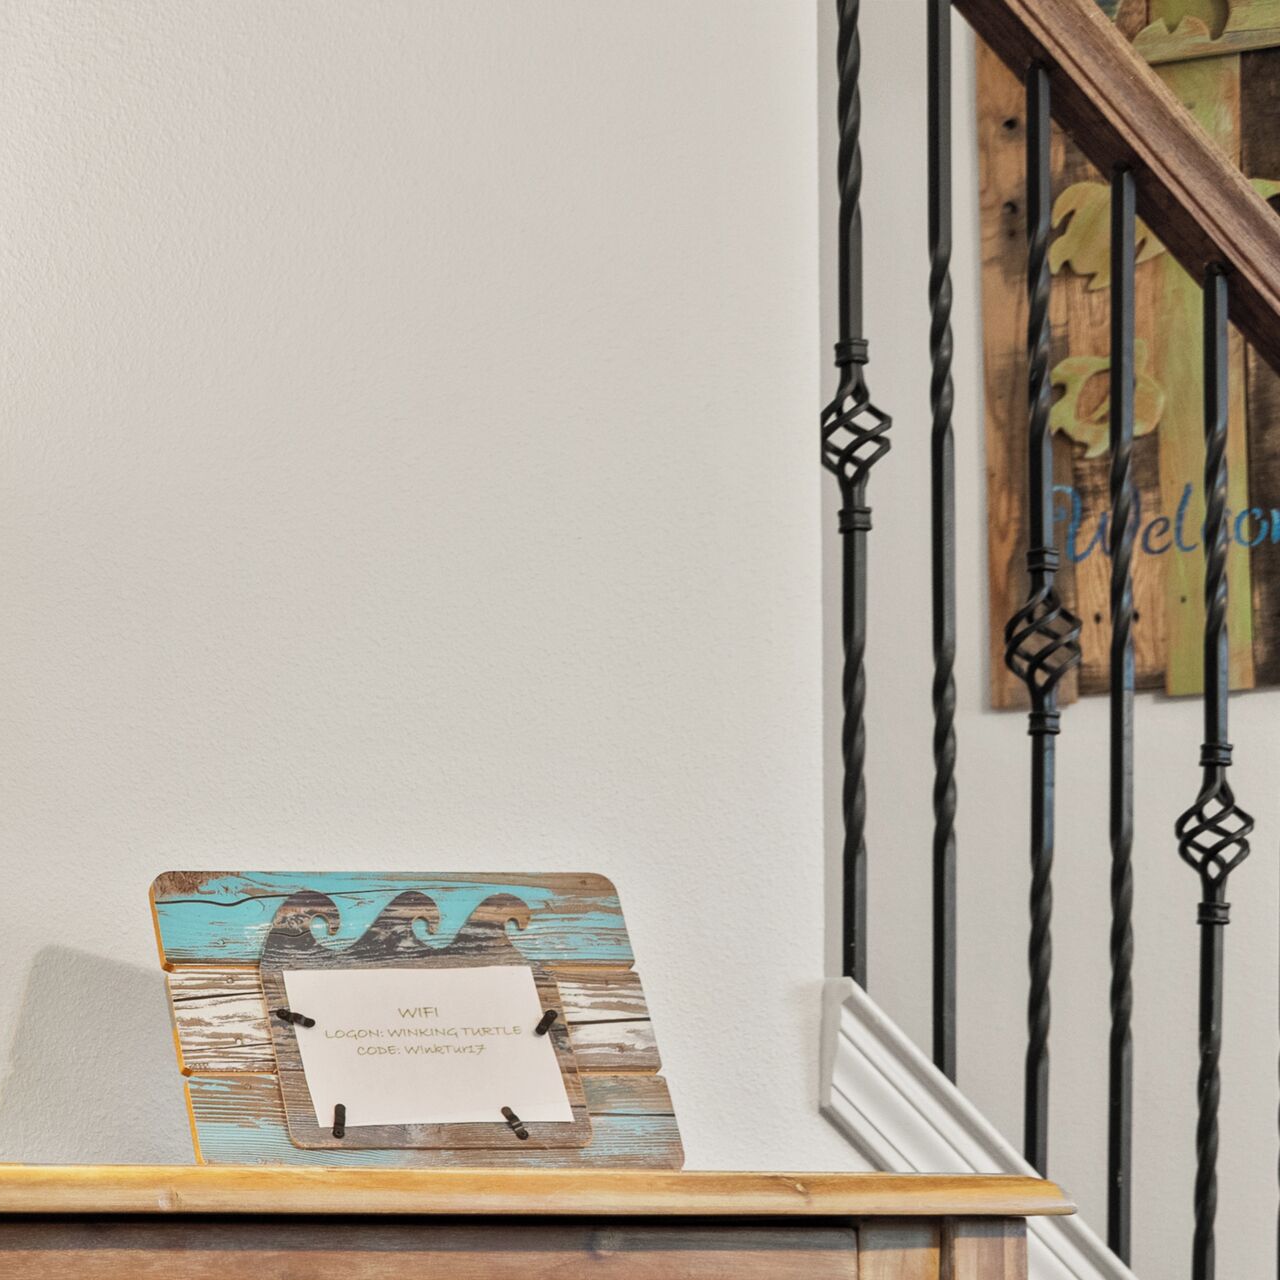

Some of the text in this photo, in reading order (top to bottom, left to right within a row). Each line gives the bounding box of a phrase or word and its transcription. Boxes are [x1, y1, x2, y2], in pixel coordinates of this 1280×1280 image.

[1051, 480, 1280, 563] Welo
[397, 1006, 439, 1019] WIFI
[325, 1025, 522, 1040] LOGON: WINKING TURTLE
[356, 1045, 401, 1056] CODE:
